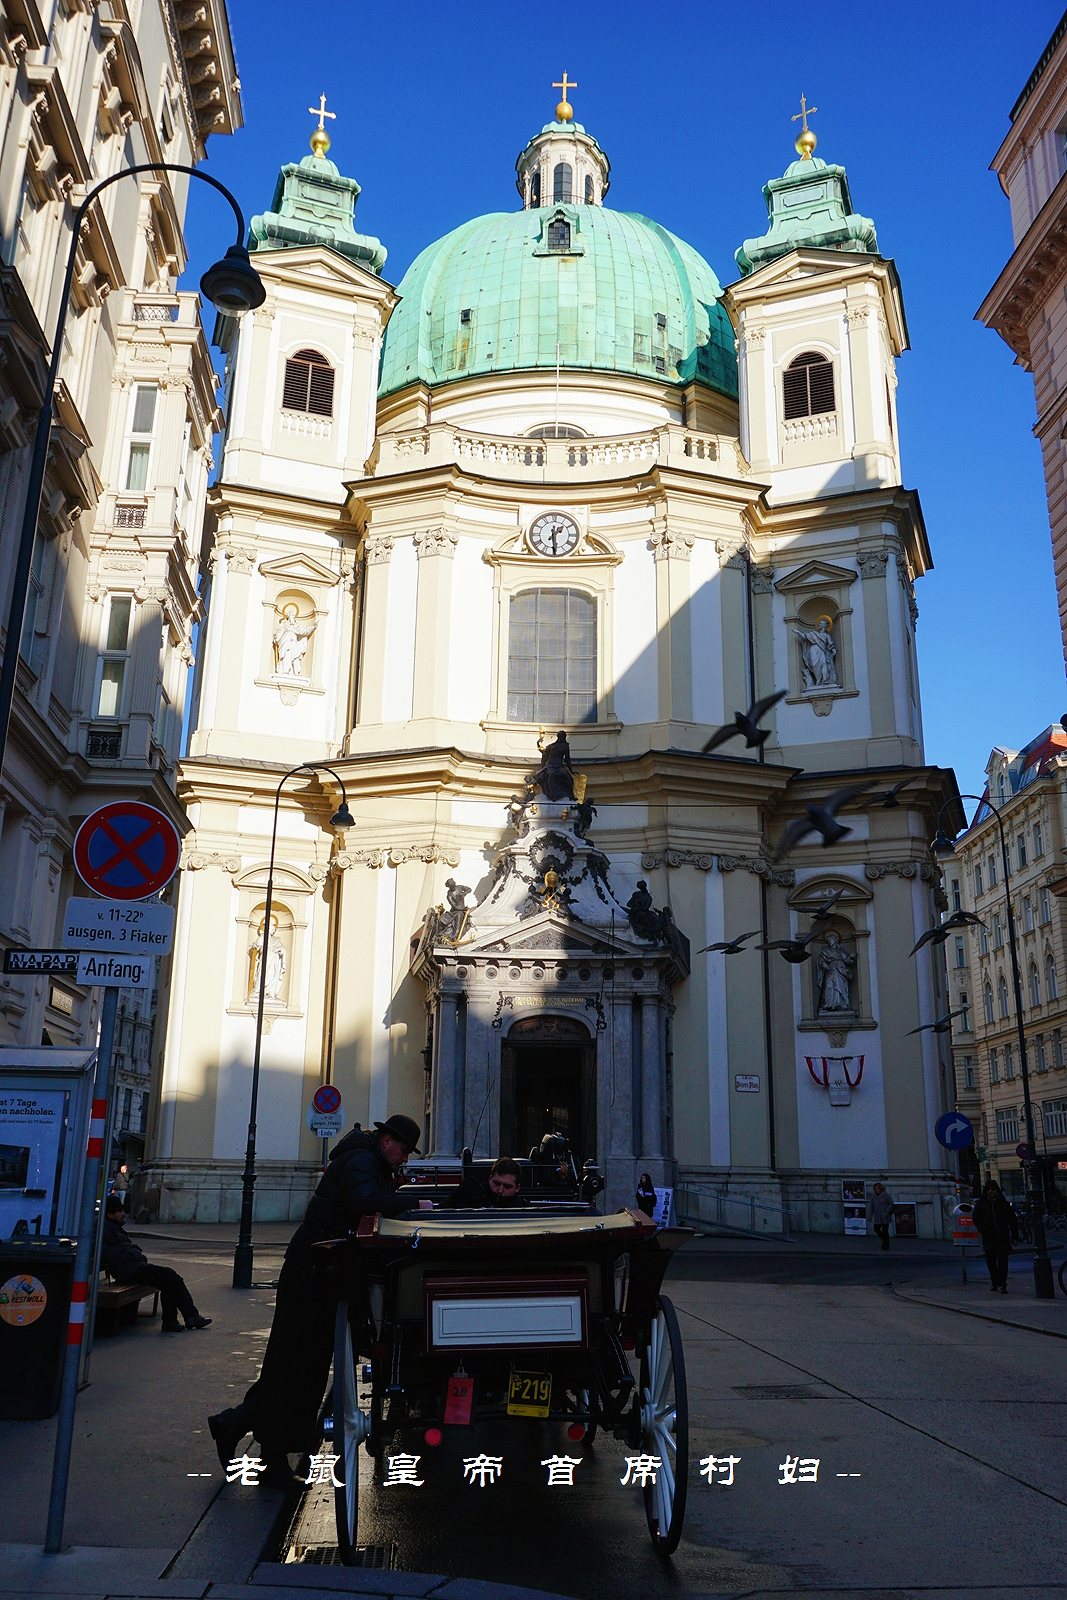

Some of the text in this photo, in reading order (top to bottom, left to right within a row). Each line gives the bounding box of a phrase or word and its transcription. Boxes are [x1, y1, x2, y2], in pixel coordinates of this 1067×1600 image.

[97, 912, 104, 920] v.
[67, 926, 168, 944] ausgen. 3 Fiaker
[85, 957, 142, 983] Anfang
[16, 1098, 37, 1108] Tage
[9, 1107, 56, 1116] nachholen.
[452, 1386, 468, 1398] 28
[510, 1378, 549, 1402] F219
